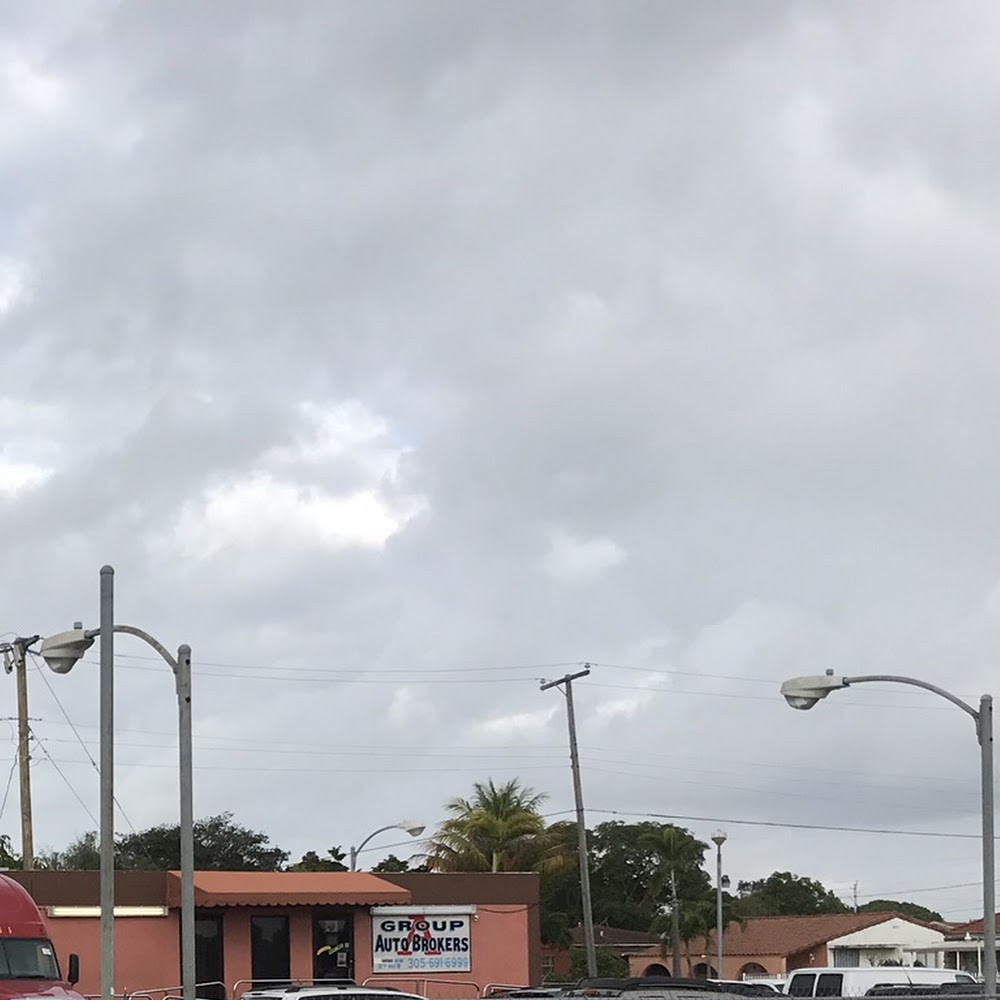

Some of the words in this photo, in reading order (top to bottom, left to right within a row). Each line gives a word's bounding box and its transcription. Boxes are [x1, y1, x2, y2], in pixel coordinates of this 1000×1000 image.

[380, 920, 464, 932] GROUP
[375, 934, 410, 952] AUTO
[412, 934, 469, 952] BROKERS
